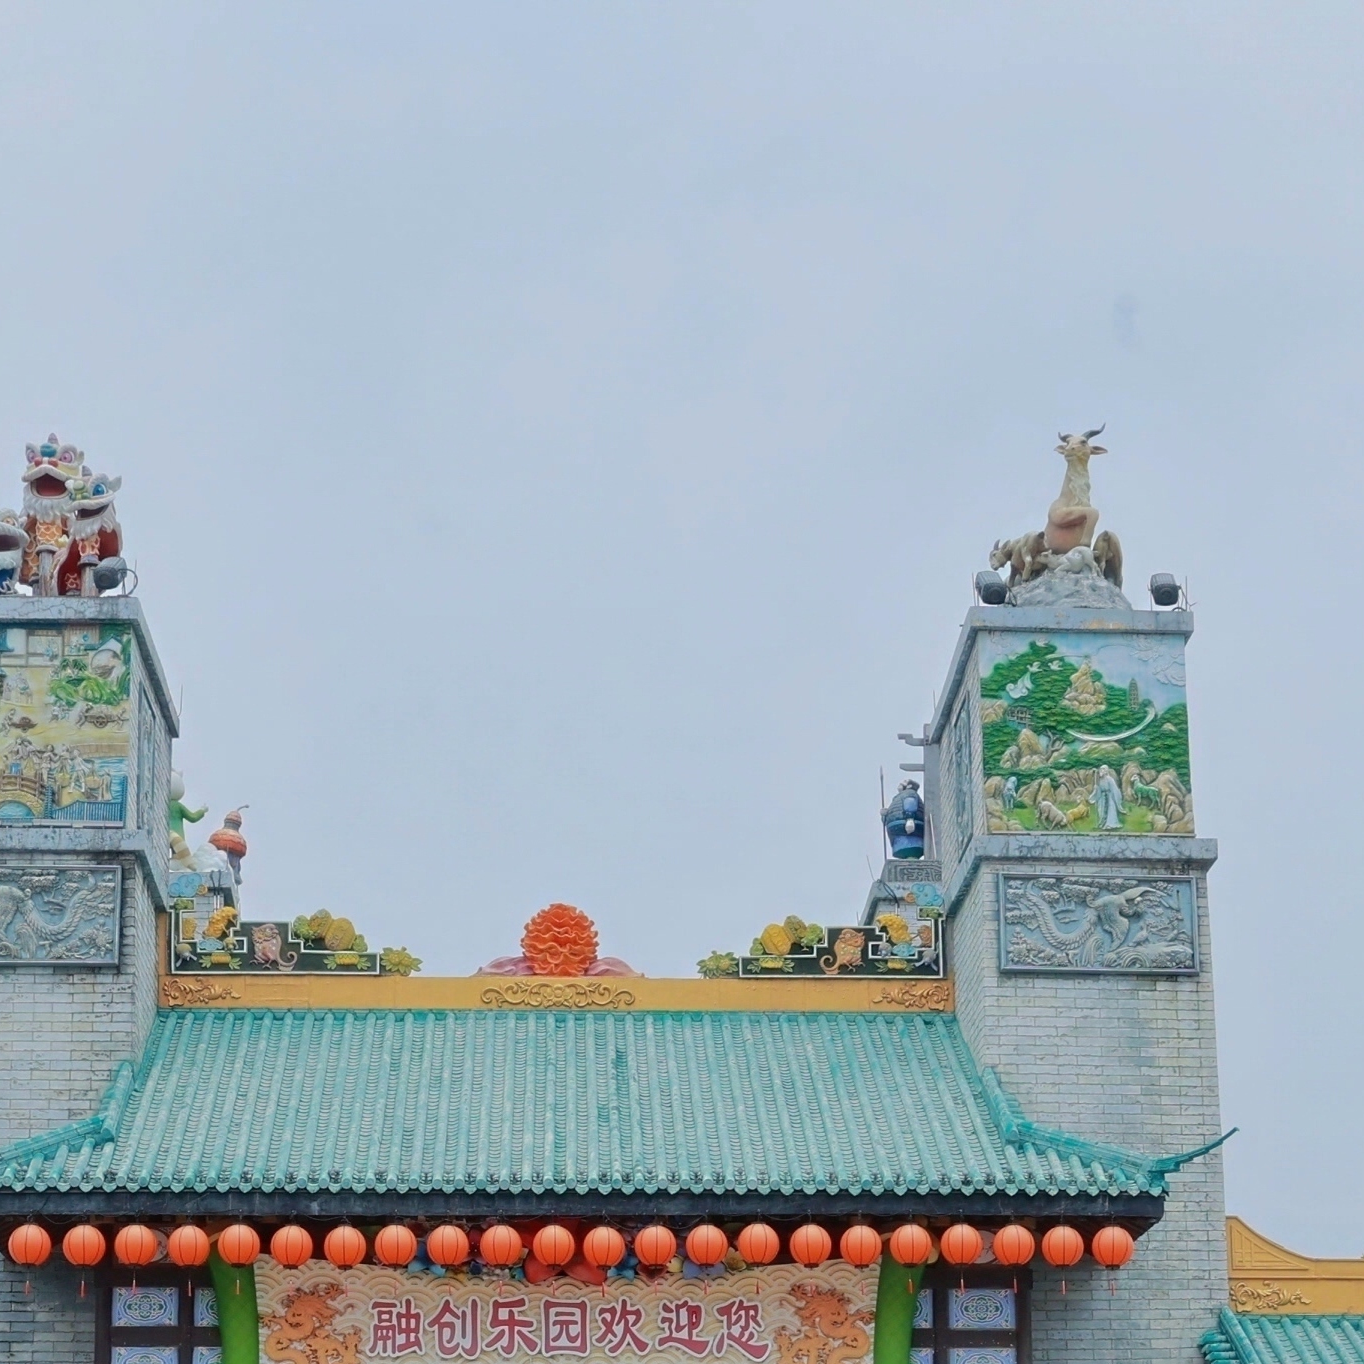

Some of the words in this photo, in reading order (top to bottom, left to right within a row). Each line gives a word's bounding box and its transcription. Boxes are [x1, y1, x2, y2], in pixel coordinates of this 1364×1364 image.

[367, 1296, 773, 1360] 融创乐园欢迎您
